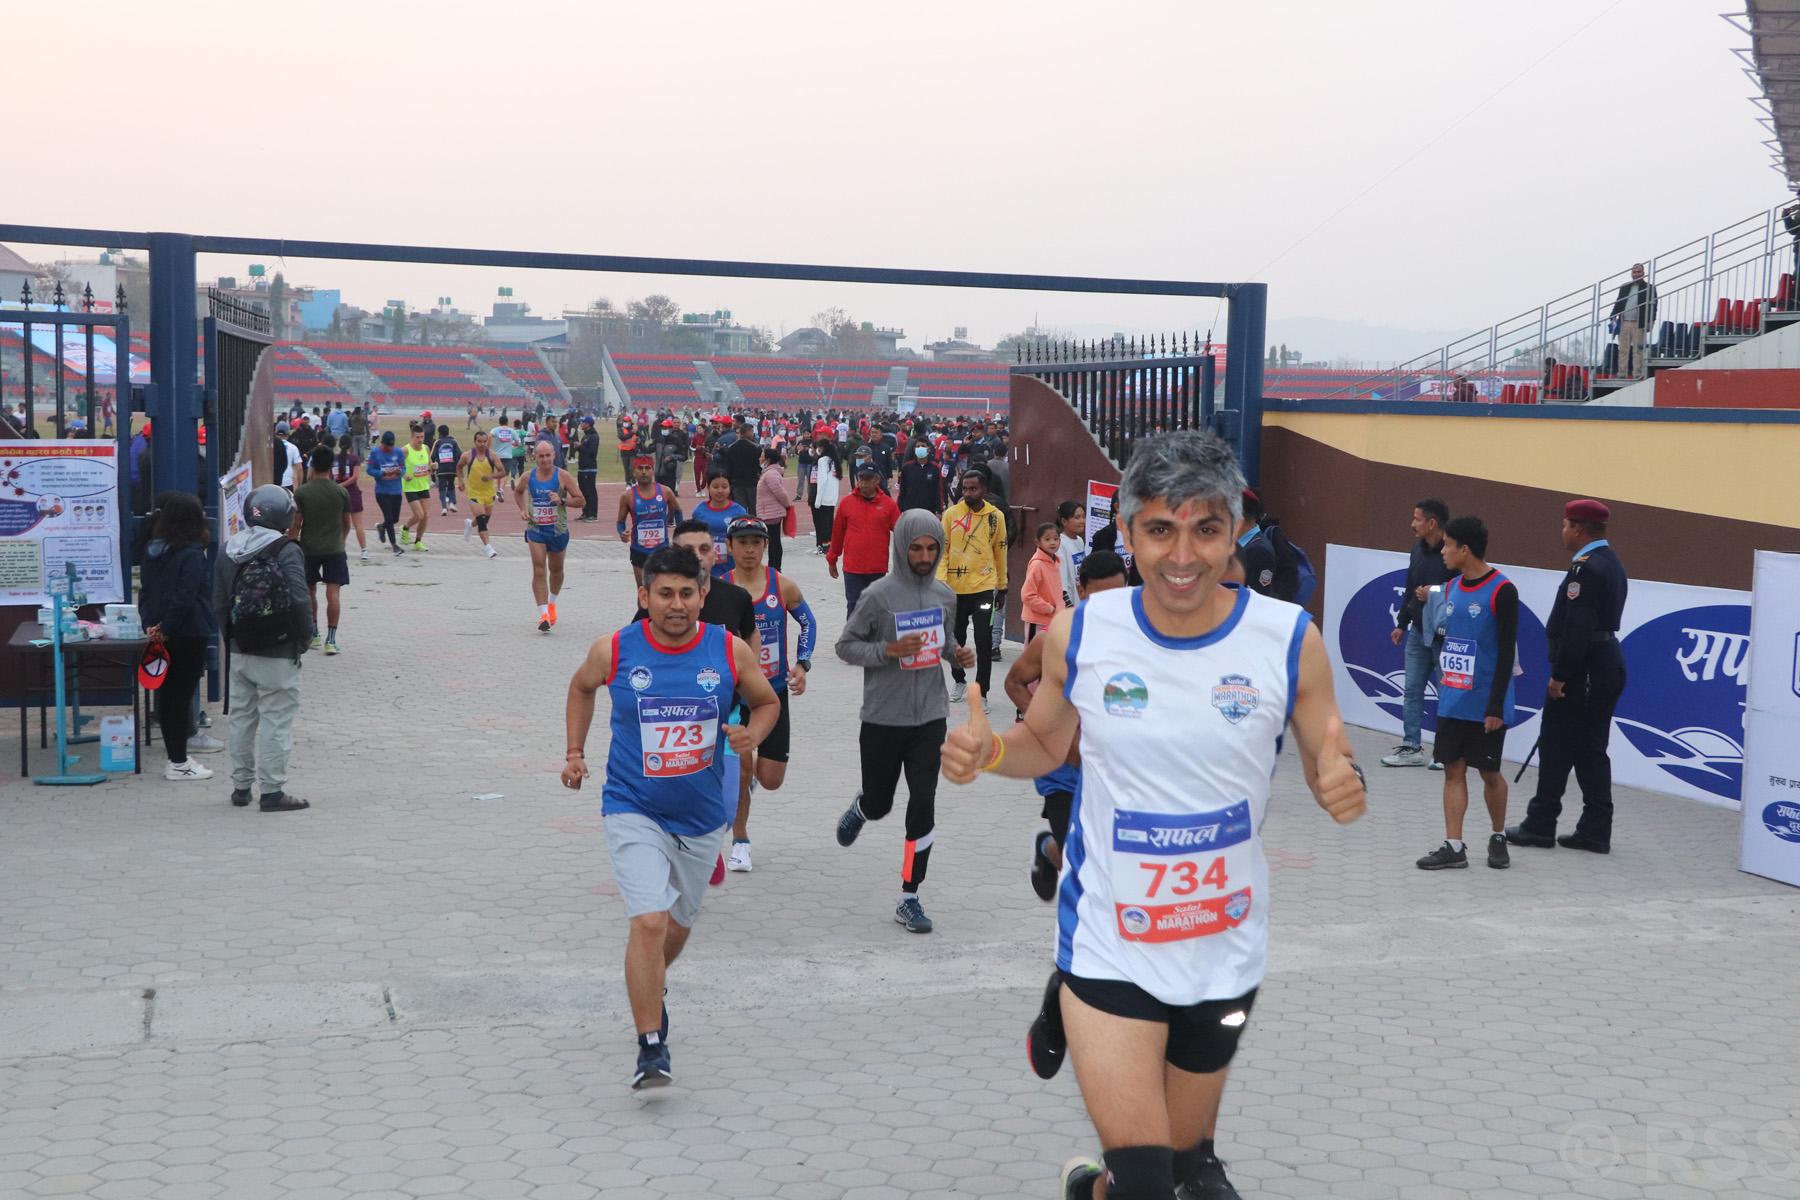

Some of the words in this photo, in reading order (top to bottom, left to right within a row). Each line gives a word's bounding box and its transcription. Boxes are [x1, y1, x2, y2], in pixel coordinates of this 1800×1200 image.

[643, 530, 660, 538] 792
[920, 630, 938, 646] 24
[1446, 641, 1470, 653] सफल
[1443, 655, 1470, 672] 1651
[1214, 690, 1257, 704] MARATHON
[660, 705, 699, 718] सफल
[655, 724, 703, 748] 723
[1149, 823, 1221, 848] सफल
[1139, 855, 1229, 898] 734
[1173, 902, 1201, 913] Safal
[1157, 911, 1218, 930] MARATHON
